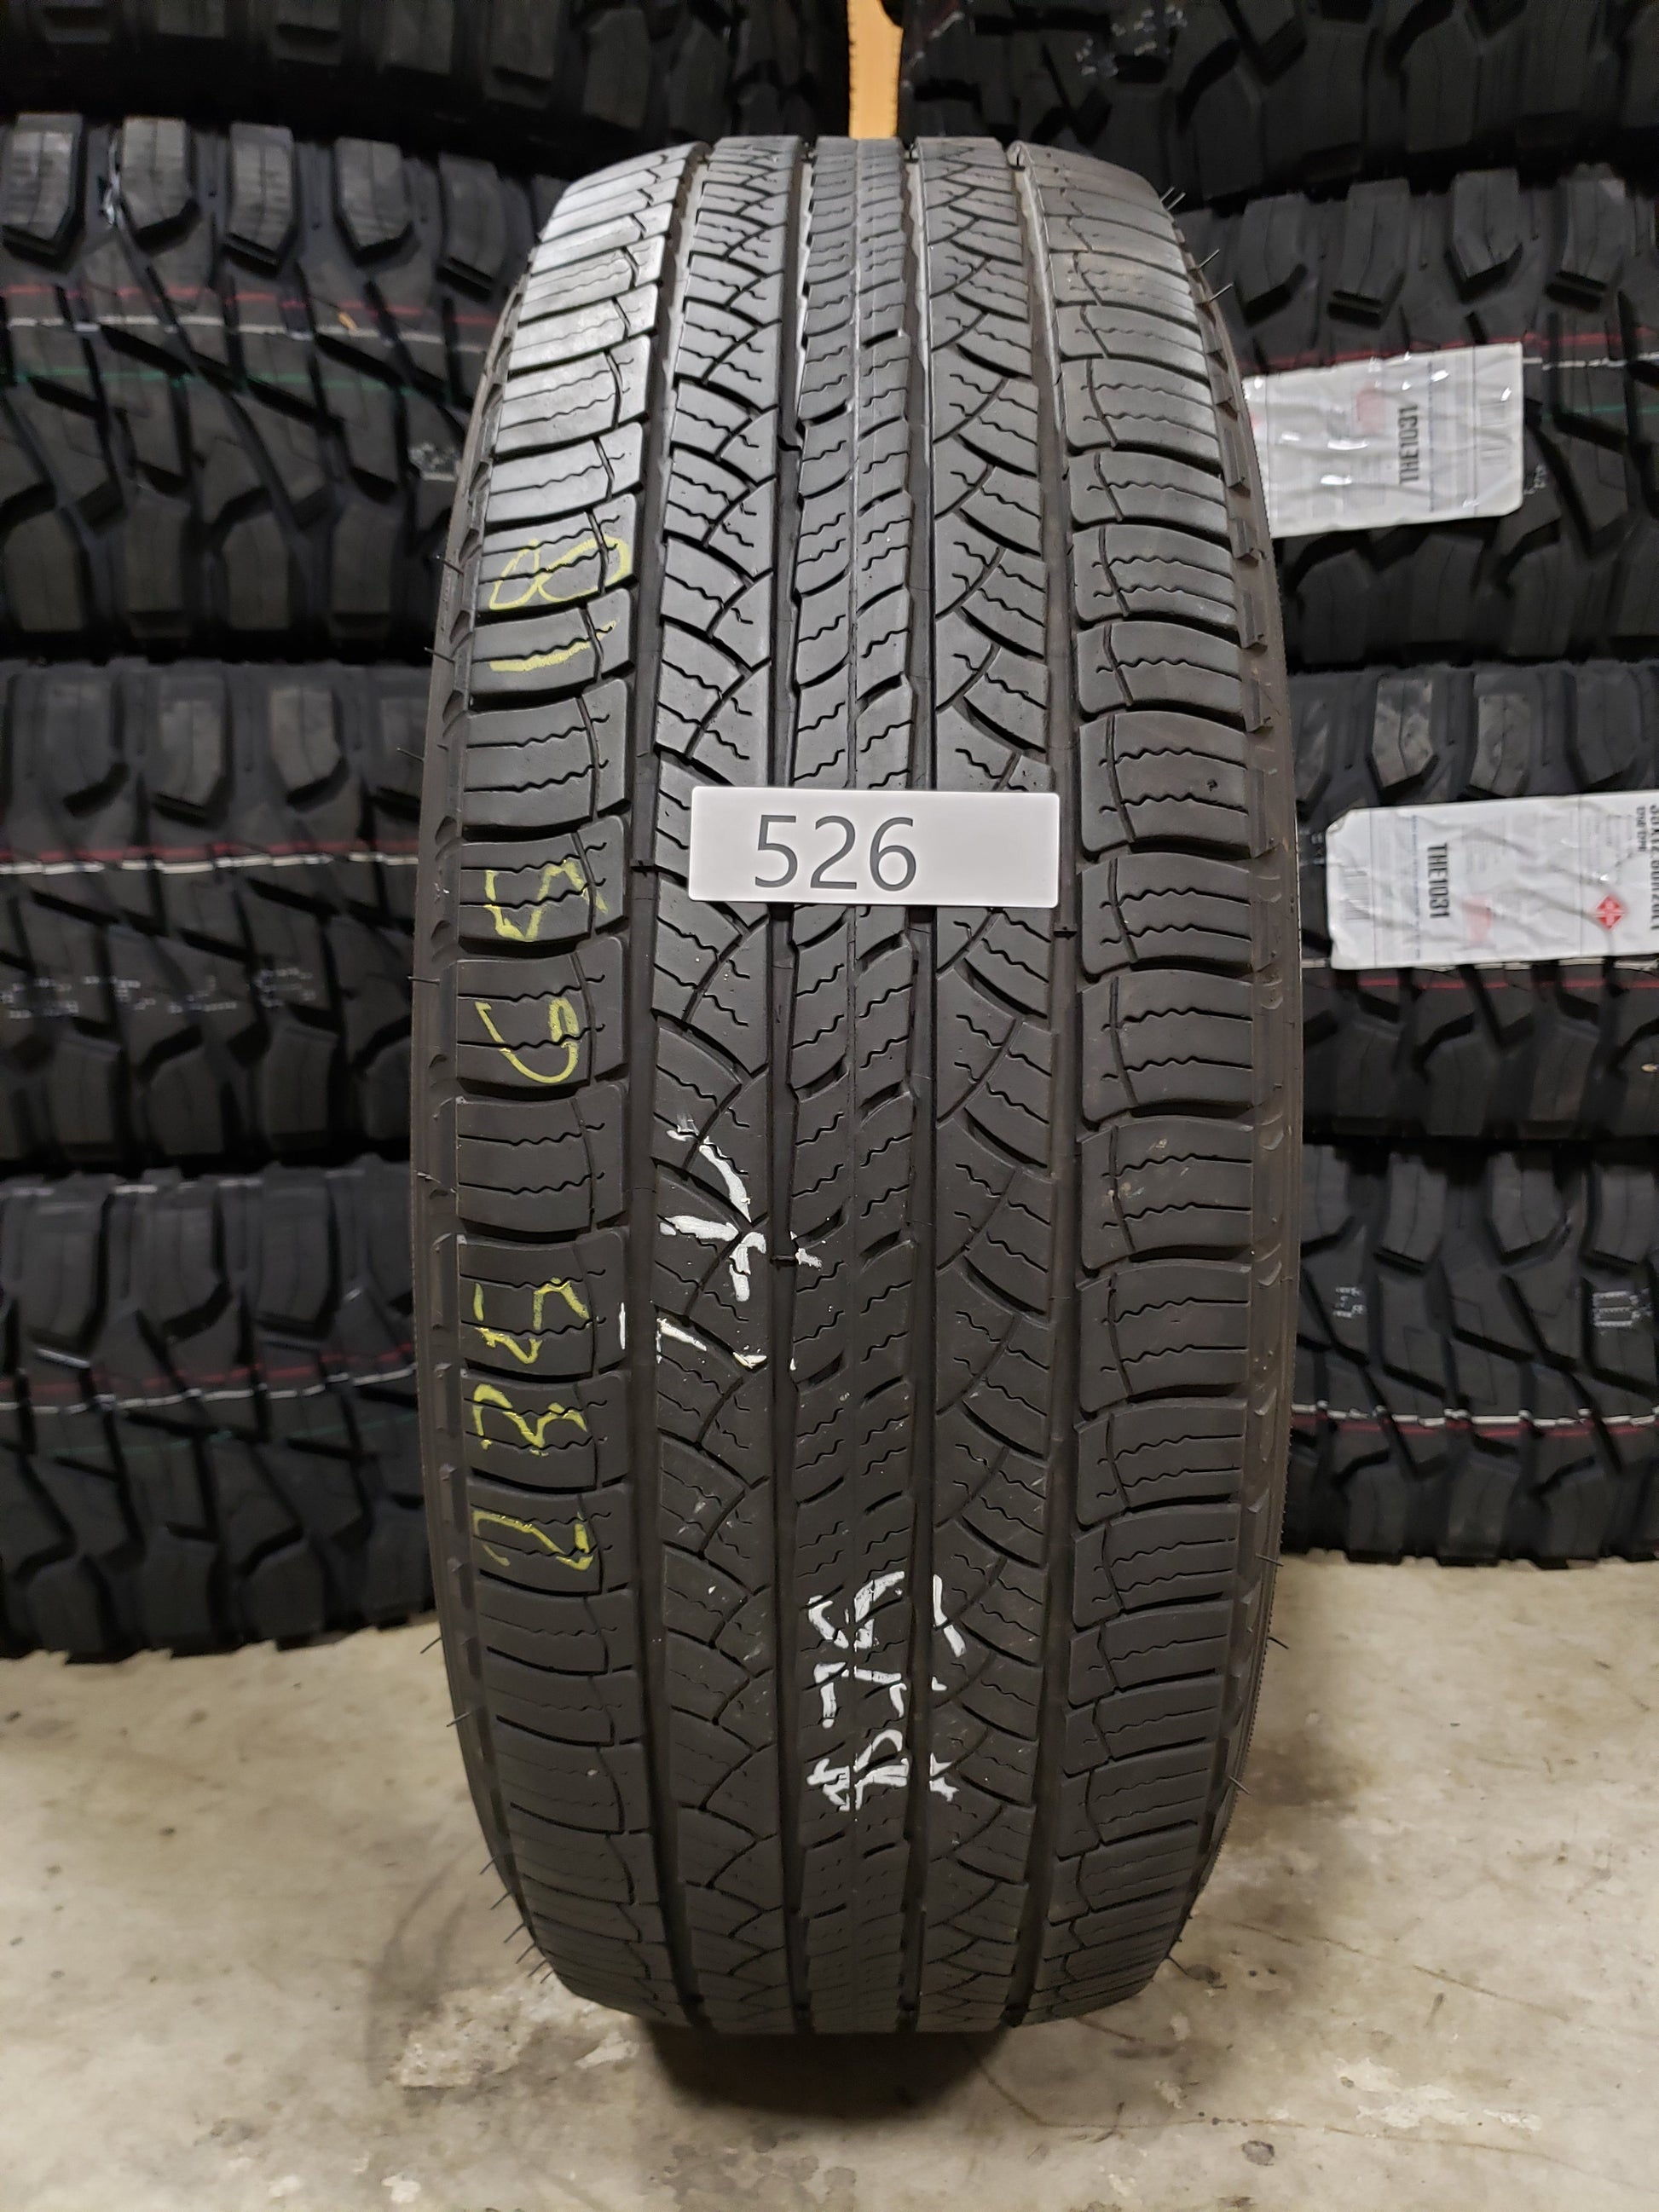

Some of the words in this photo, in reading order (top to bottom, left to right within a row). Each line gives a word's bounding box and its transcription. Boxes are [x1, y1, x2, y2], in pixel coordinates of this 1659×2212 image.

[1398, 404, 1419, 484] THE1031
[754, 814, 917, 892] 526
[1427, 842, 1450, 919] THE1031
[474, 858, 606, 1085] 65
[471, 1277, 592, 1571] 235
